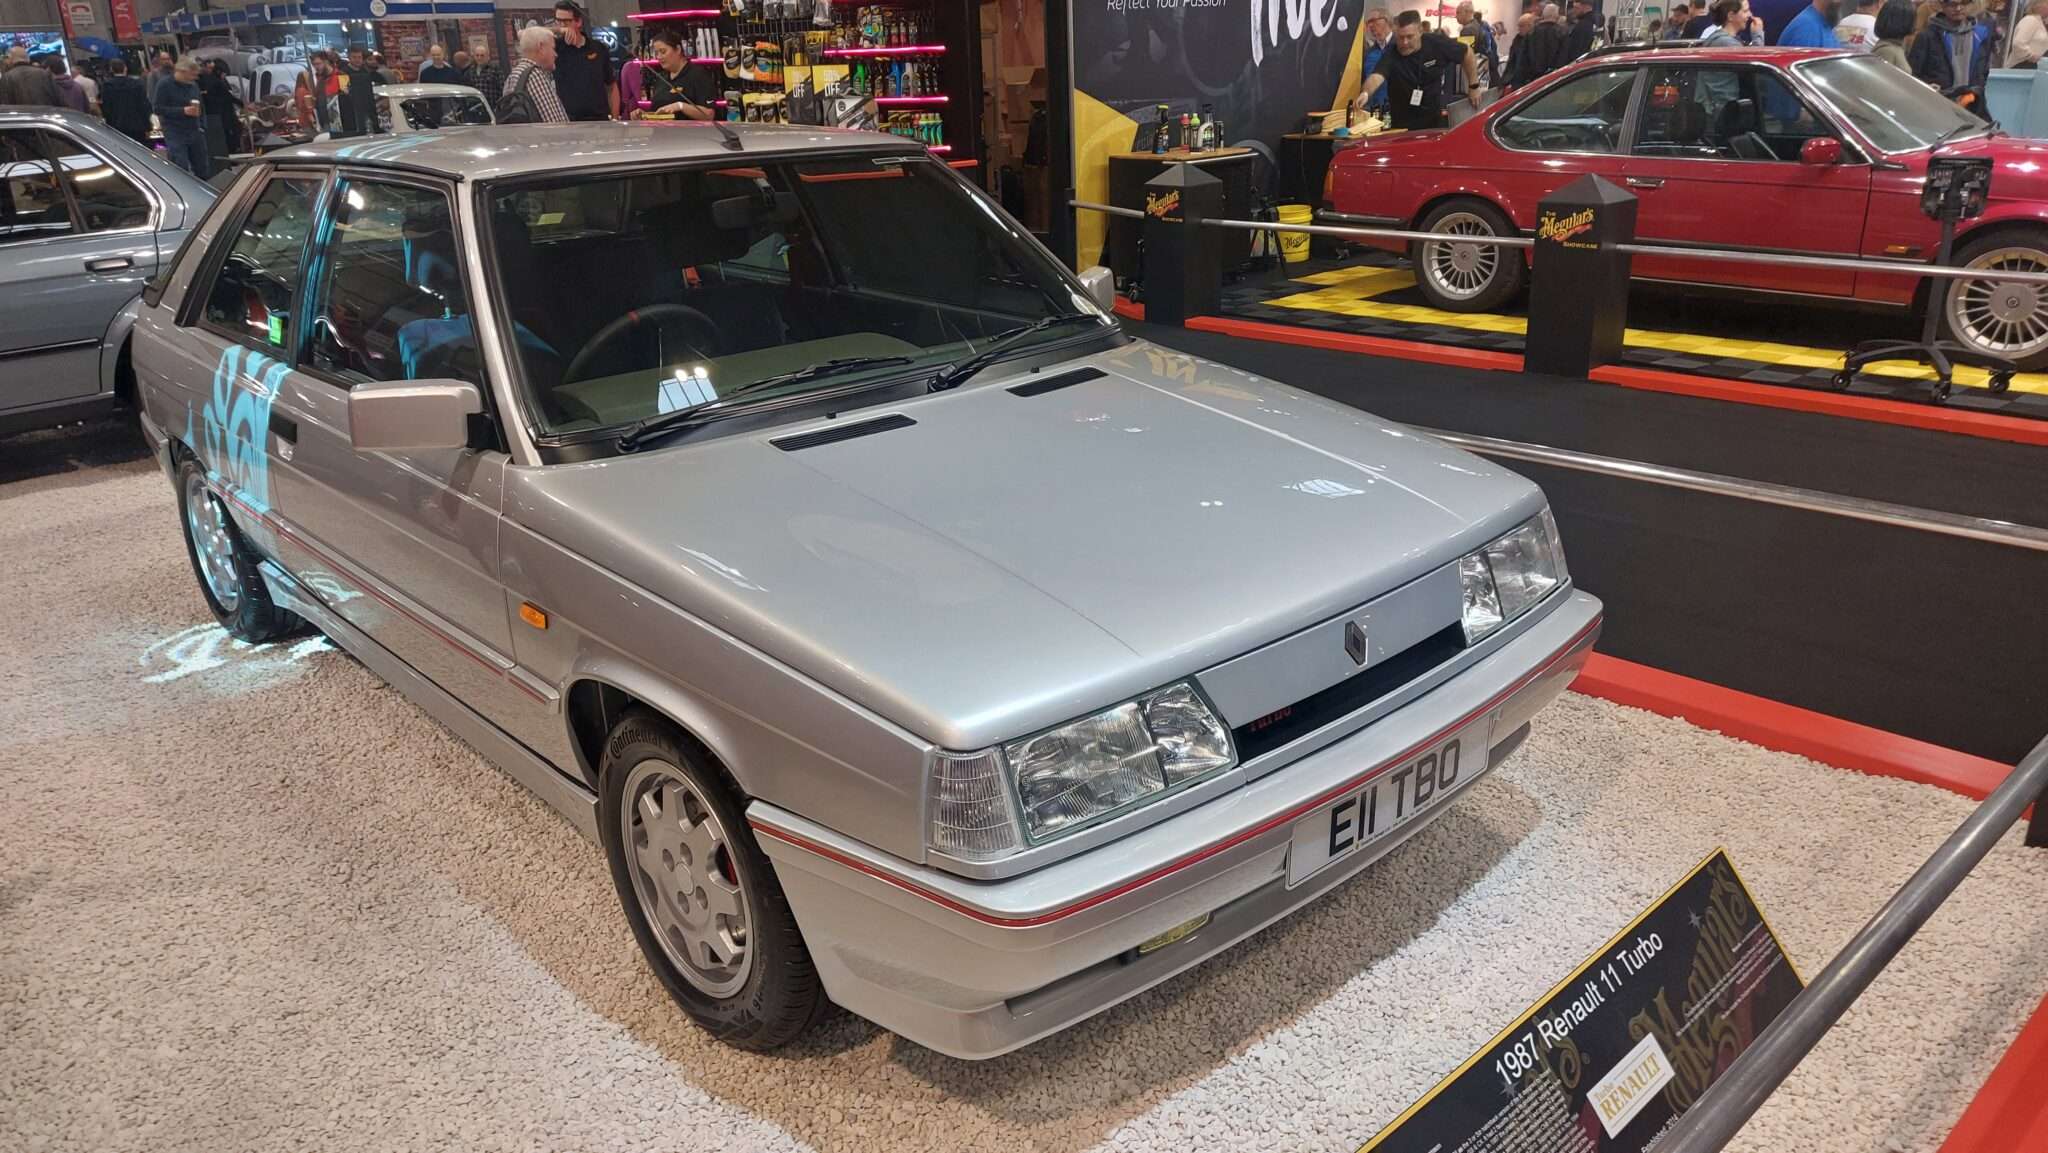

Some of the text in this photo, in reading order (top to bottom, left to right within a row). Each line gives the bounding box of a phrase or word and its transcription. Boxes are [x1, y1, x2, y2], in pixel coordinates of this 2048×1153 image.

[824, 82, 841, 97] OFF
[610, 726, 662, 759] Continental
[1329, 785, 1378, 857] E11
[1391, 738, 1460, 820] TBO
[1496, 1032, 1540, 1085] 1987
[1537, 980, 1606, 1049] Renault
[1600, 963, 1623, 993] 11
[1616, 933, 1663, 976] Turbo
[1599, 1052, 1661, 1121] RENAULT
